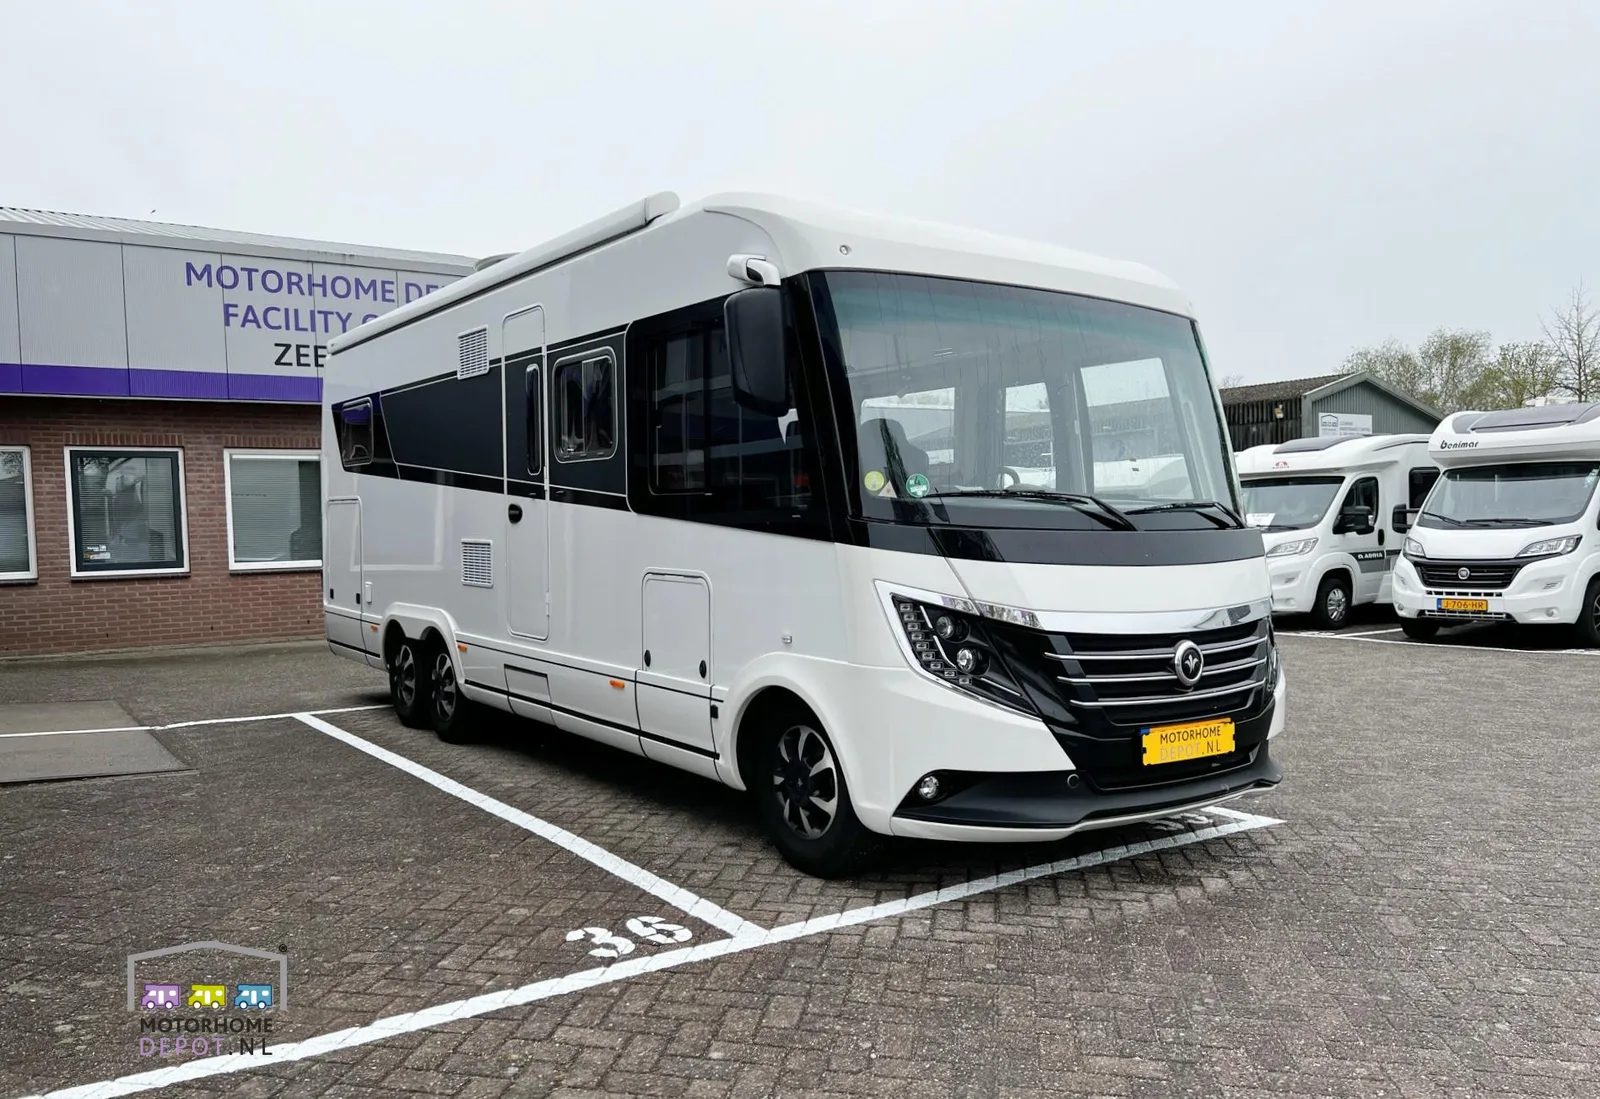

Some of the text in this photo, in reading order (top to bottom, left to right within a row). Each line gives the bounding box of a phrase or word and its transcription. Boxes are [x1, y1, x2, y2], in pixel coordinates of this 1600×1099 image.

[185, 262, 396, 303] MOTORHOME
[223, 303, 352, 333] FACILITY
[1440, 439, 1479, 449] benimar
[1443, 600, 1485, 609] J-706-HR
[1160, 725, 1221, 744] MOTORHOME
[1160, 740, 1221, 761] DEPOT.NL
[565, 915, 693, 958] 36
